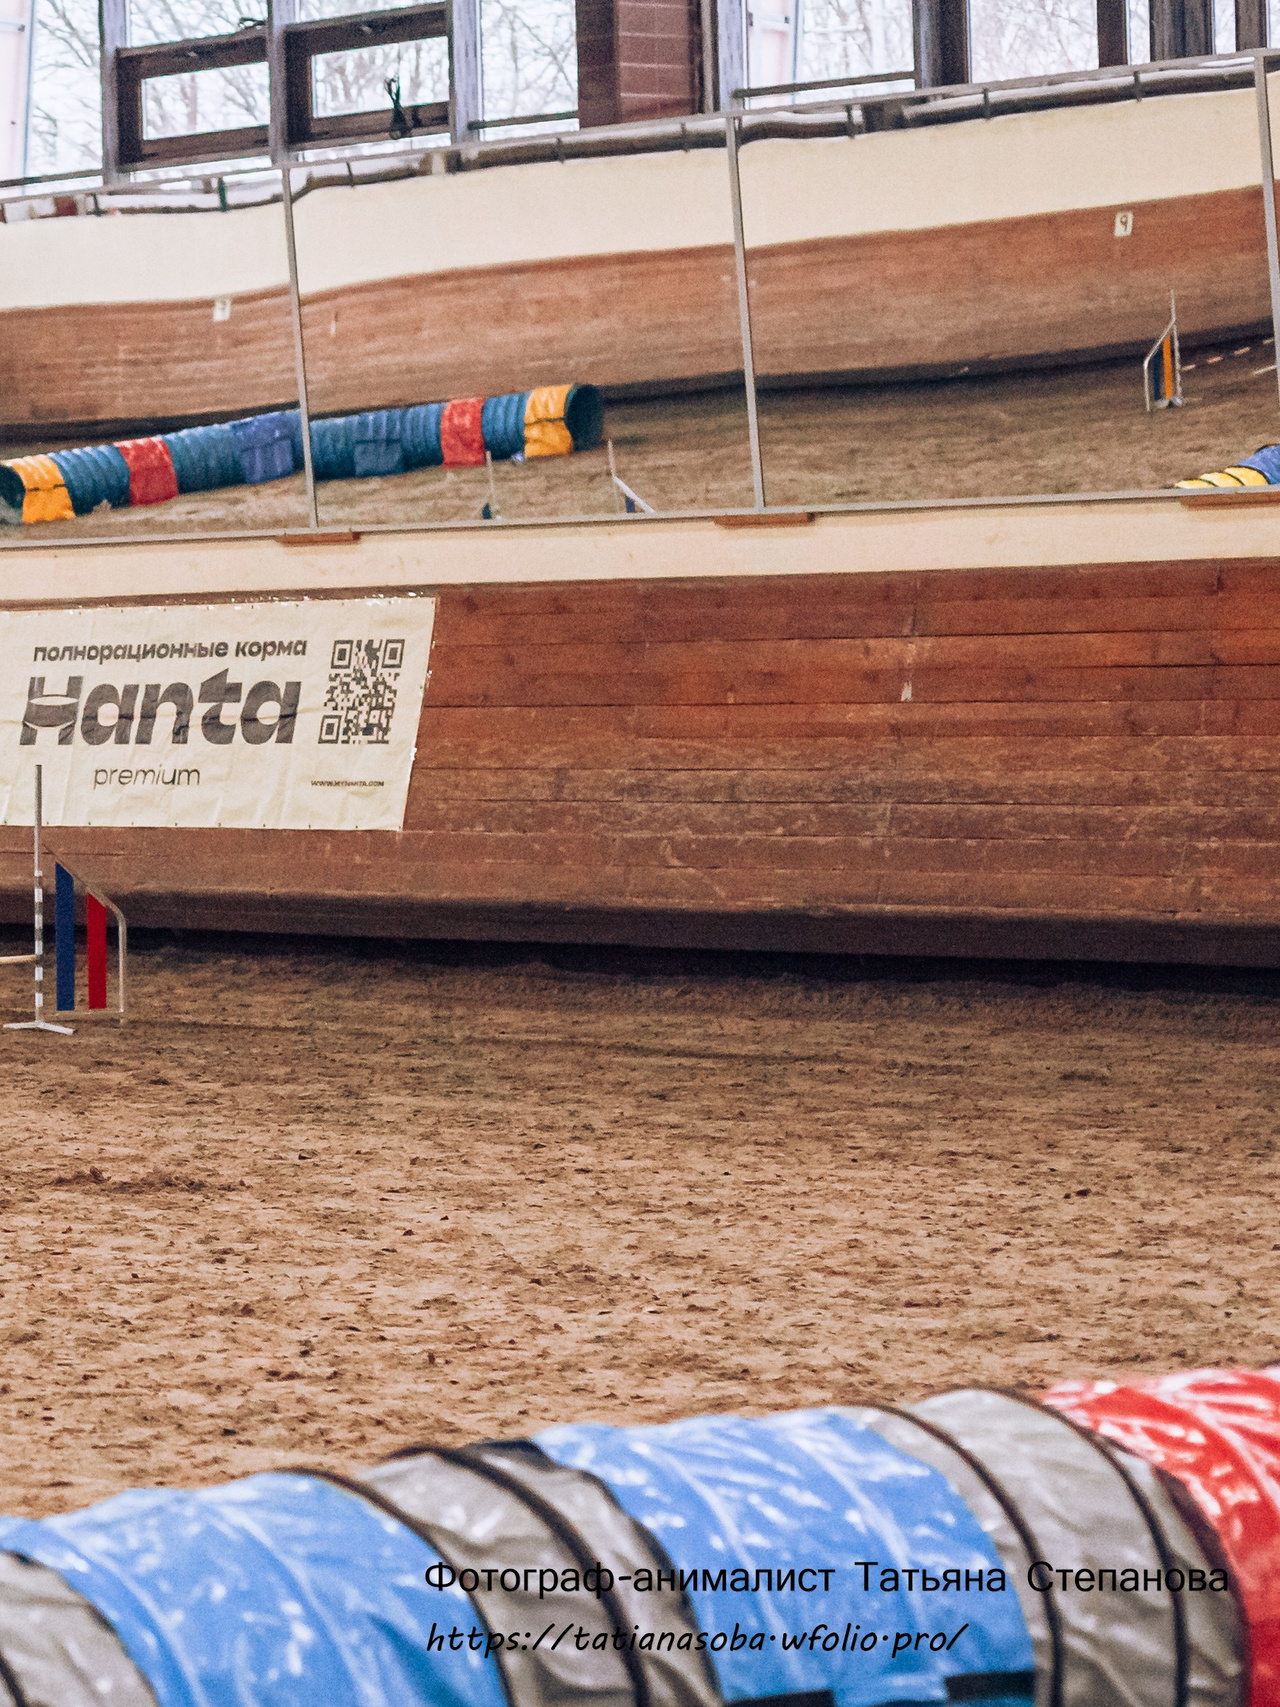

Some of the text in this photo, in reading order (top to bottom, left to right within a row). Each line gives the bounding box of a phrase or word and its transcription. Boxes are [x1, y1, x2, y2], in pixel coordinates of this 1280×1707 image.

[33, 639, 308, 666] полнорационные корма
[19, 668, 302, 746] Hanta
[93, 764, 201, 789] premium
